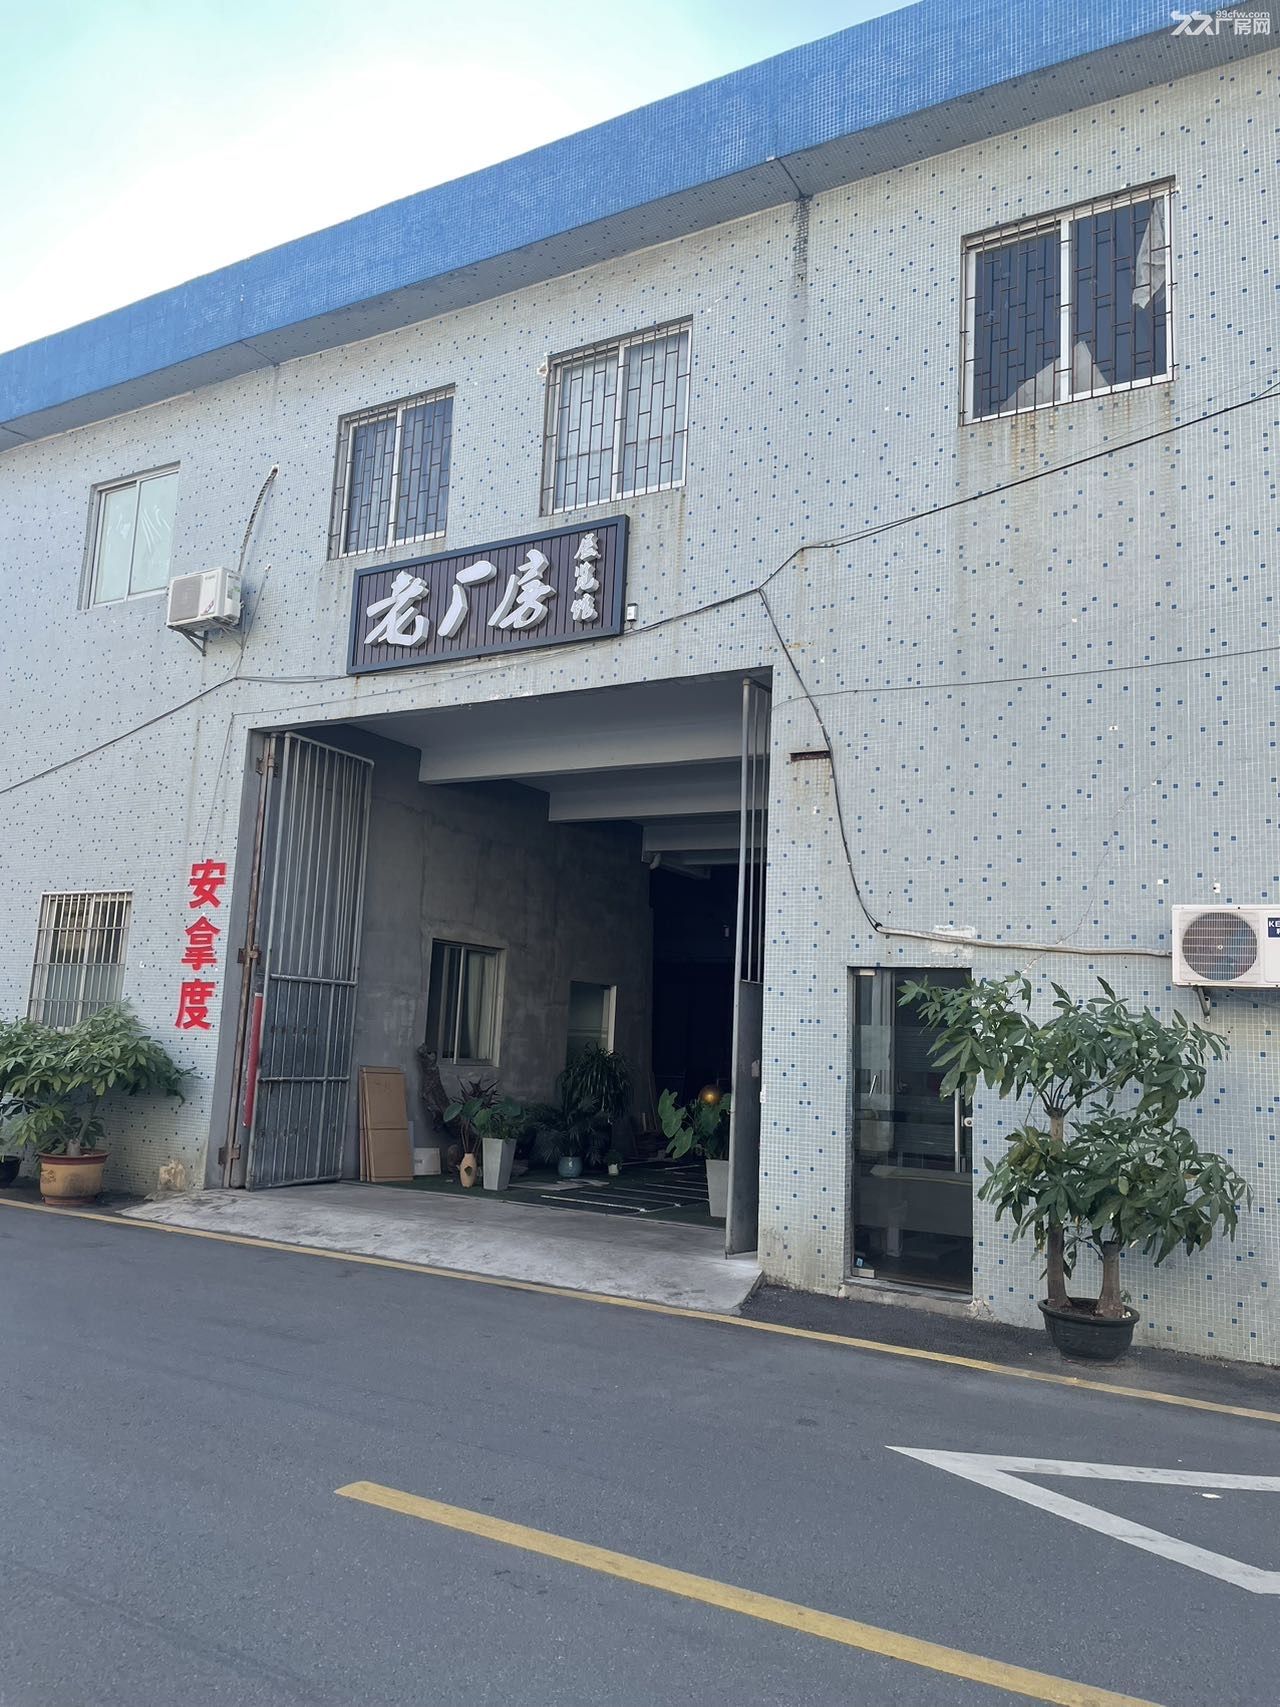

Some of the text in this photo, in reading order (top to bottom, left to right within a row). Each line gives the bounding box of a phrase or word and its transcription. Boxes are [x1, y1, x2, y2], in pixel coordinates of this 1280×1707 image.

[364, 548, 556, 648] 老厂房
[175, 859, 227, 1030] 安拿度
